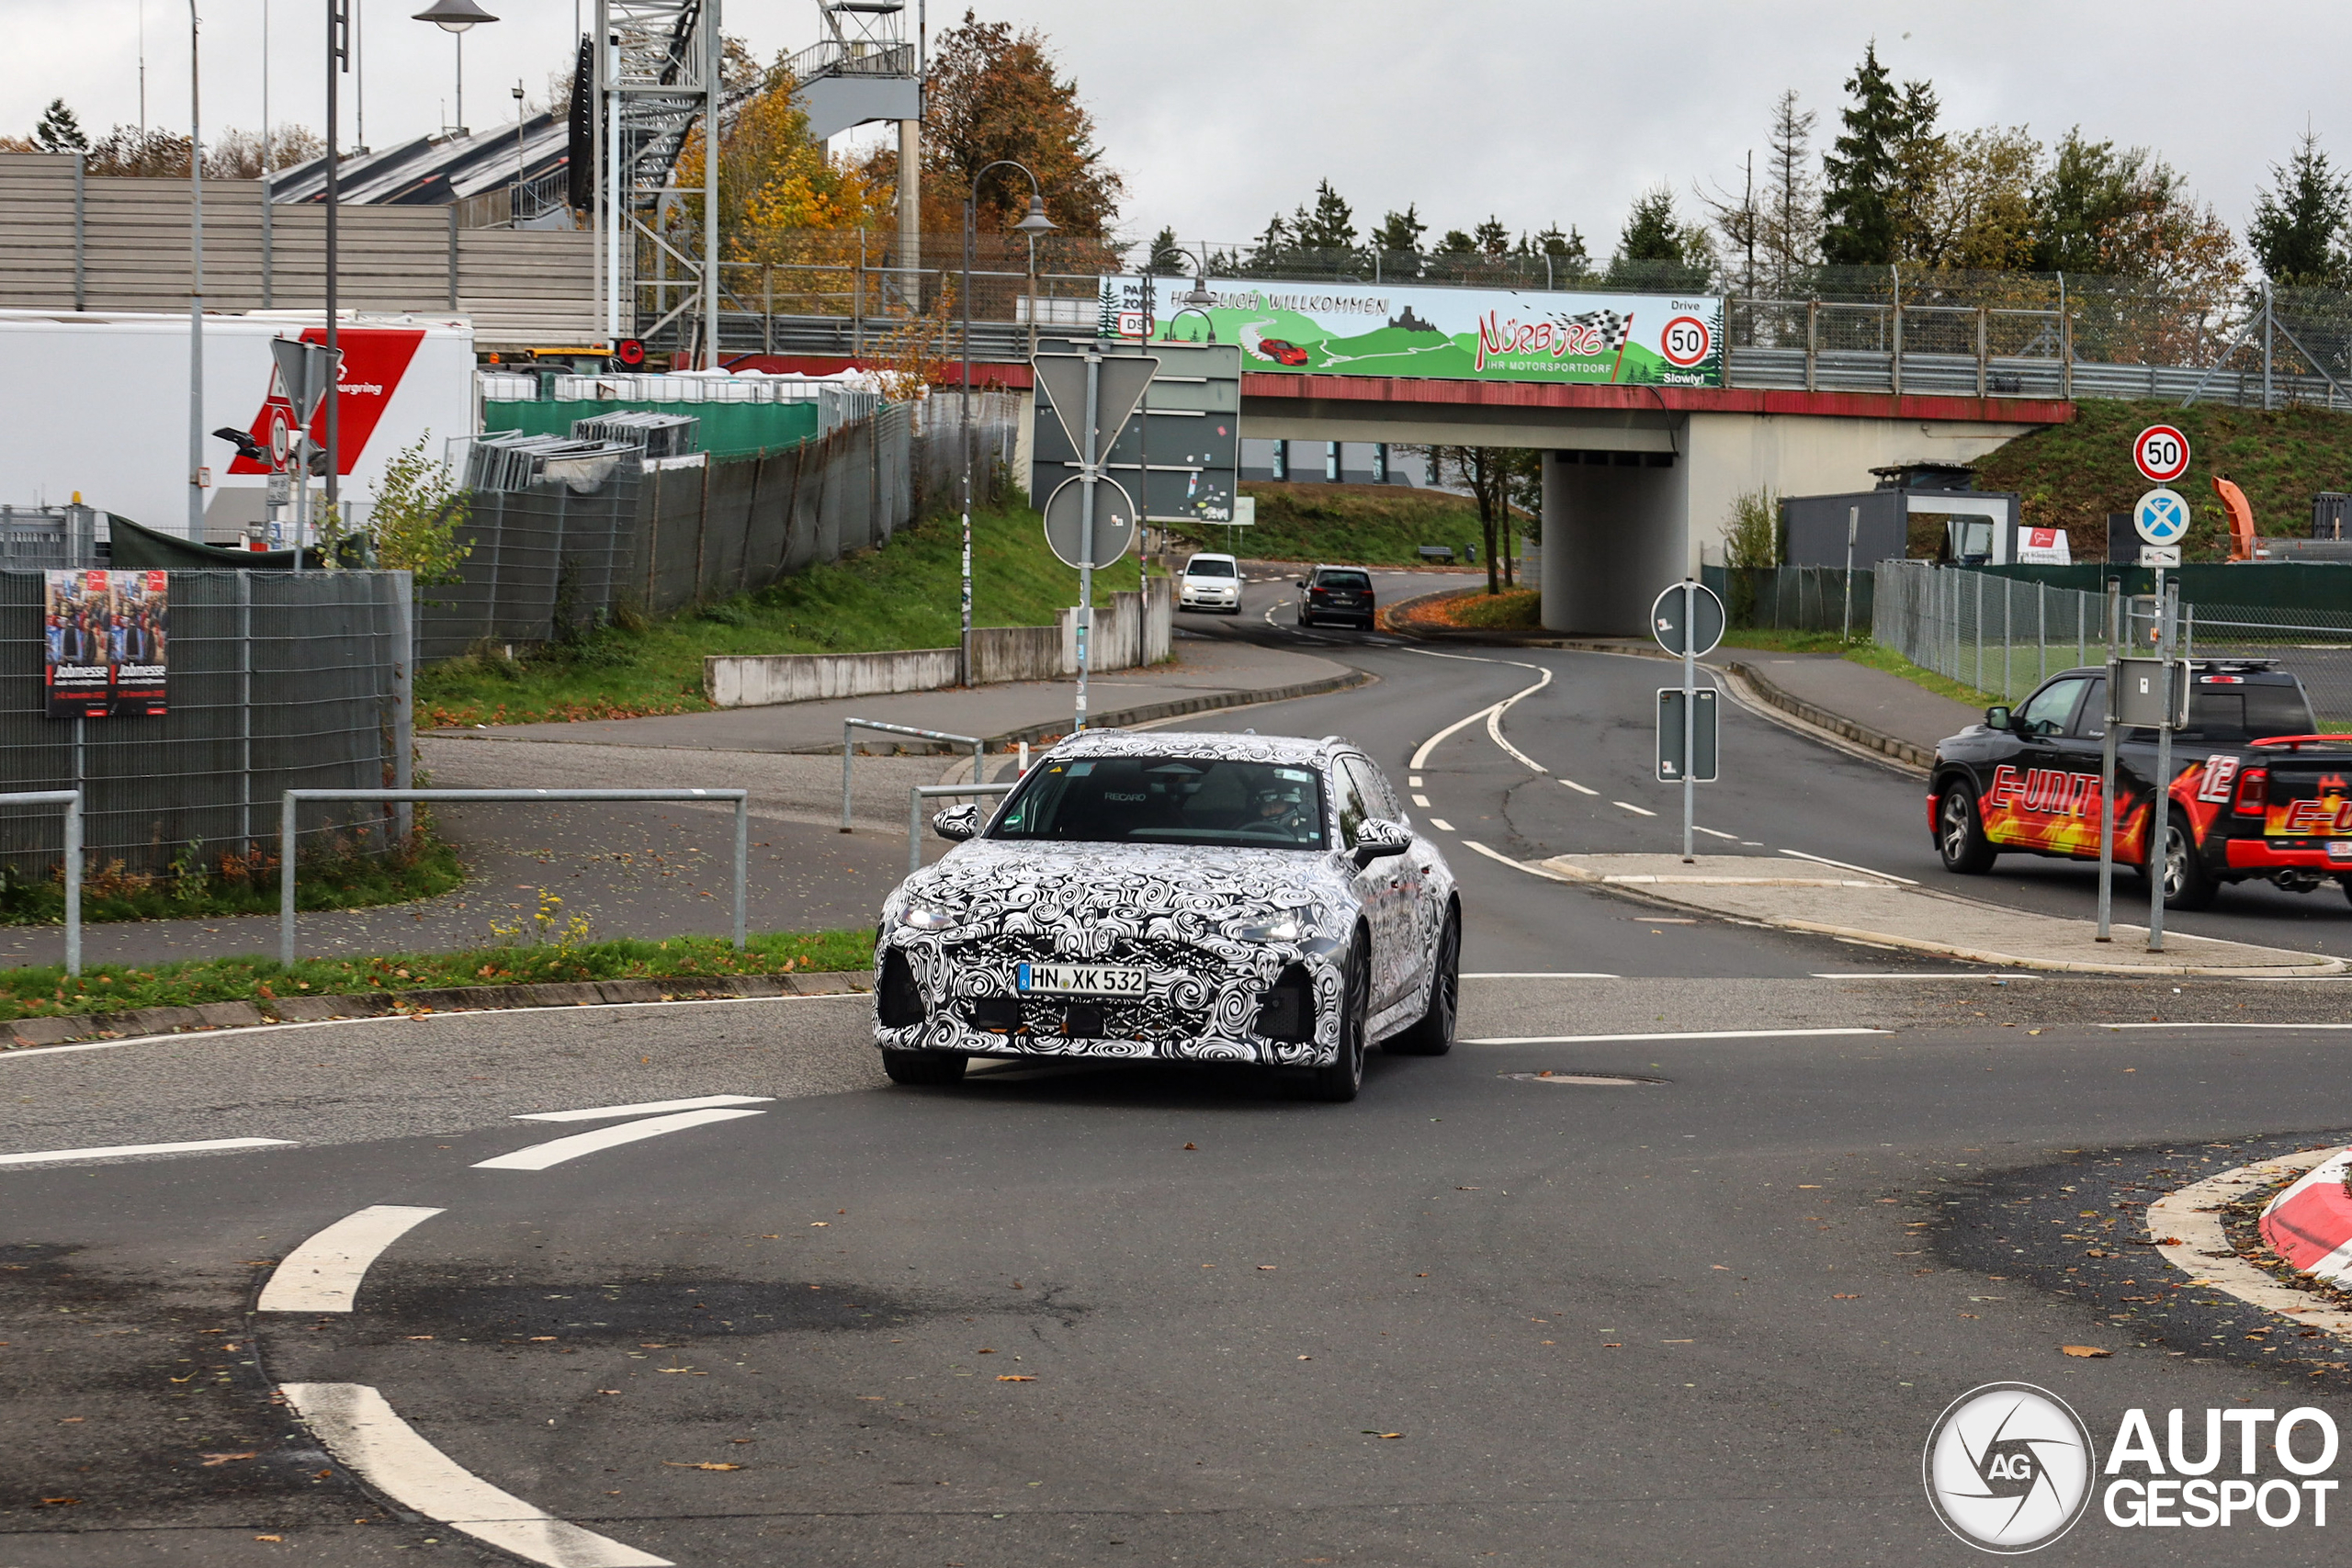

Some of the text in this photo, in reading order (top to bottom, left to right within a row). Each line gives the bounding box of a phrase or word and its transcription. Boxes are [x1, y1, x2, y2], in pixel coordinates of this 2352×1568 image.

[1170, 290, 1390, 315] HEZLICH WILLKOMMEN
[1671, 300, 1701, 310] Drive
[1475, 310, 1603, 372] NÜRBURG
[1671, 330, 1699, 352] 50
[1487, 360, 1611, 373] IHR MOTORSPORTDORF
[336, 381, 382, 395] urgring
[1663, 373, 1704, 386] Slowly!
[2148, 442, 2177, 465] 50
[2197, 754, 2240, 803] 12
[1104, 792, 1146, 802] RECARO
[1990, 764, 2100, 817] E-UNIT
[1031, 967, 1142, 991] HN XK 532
